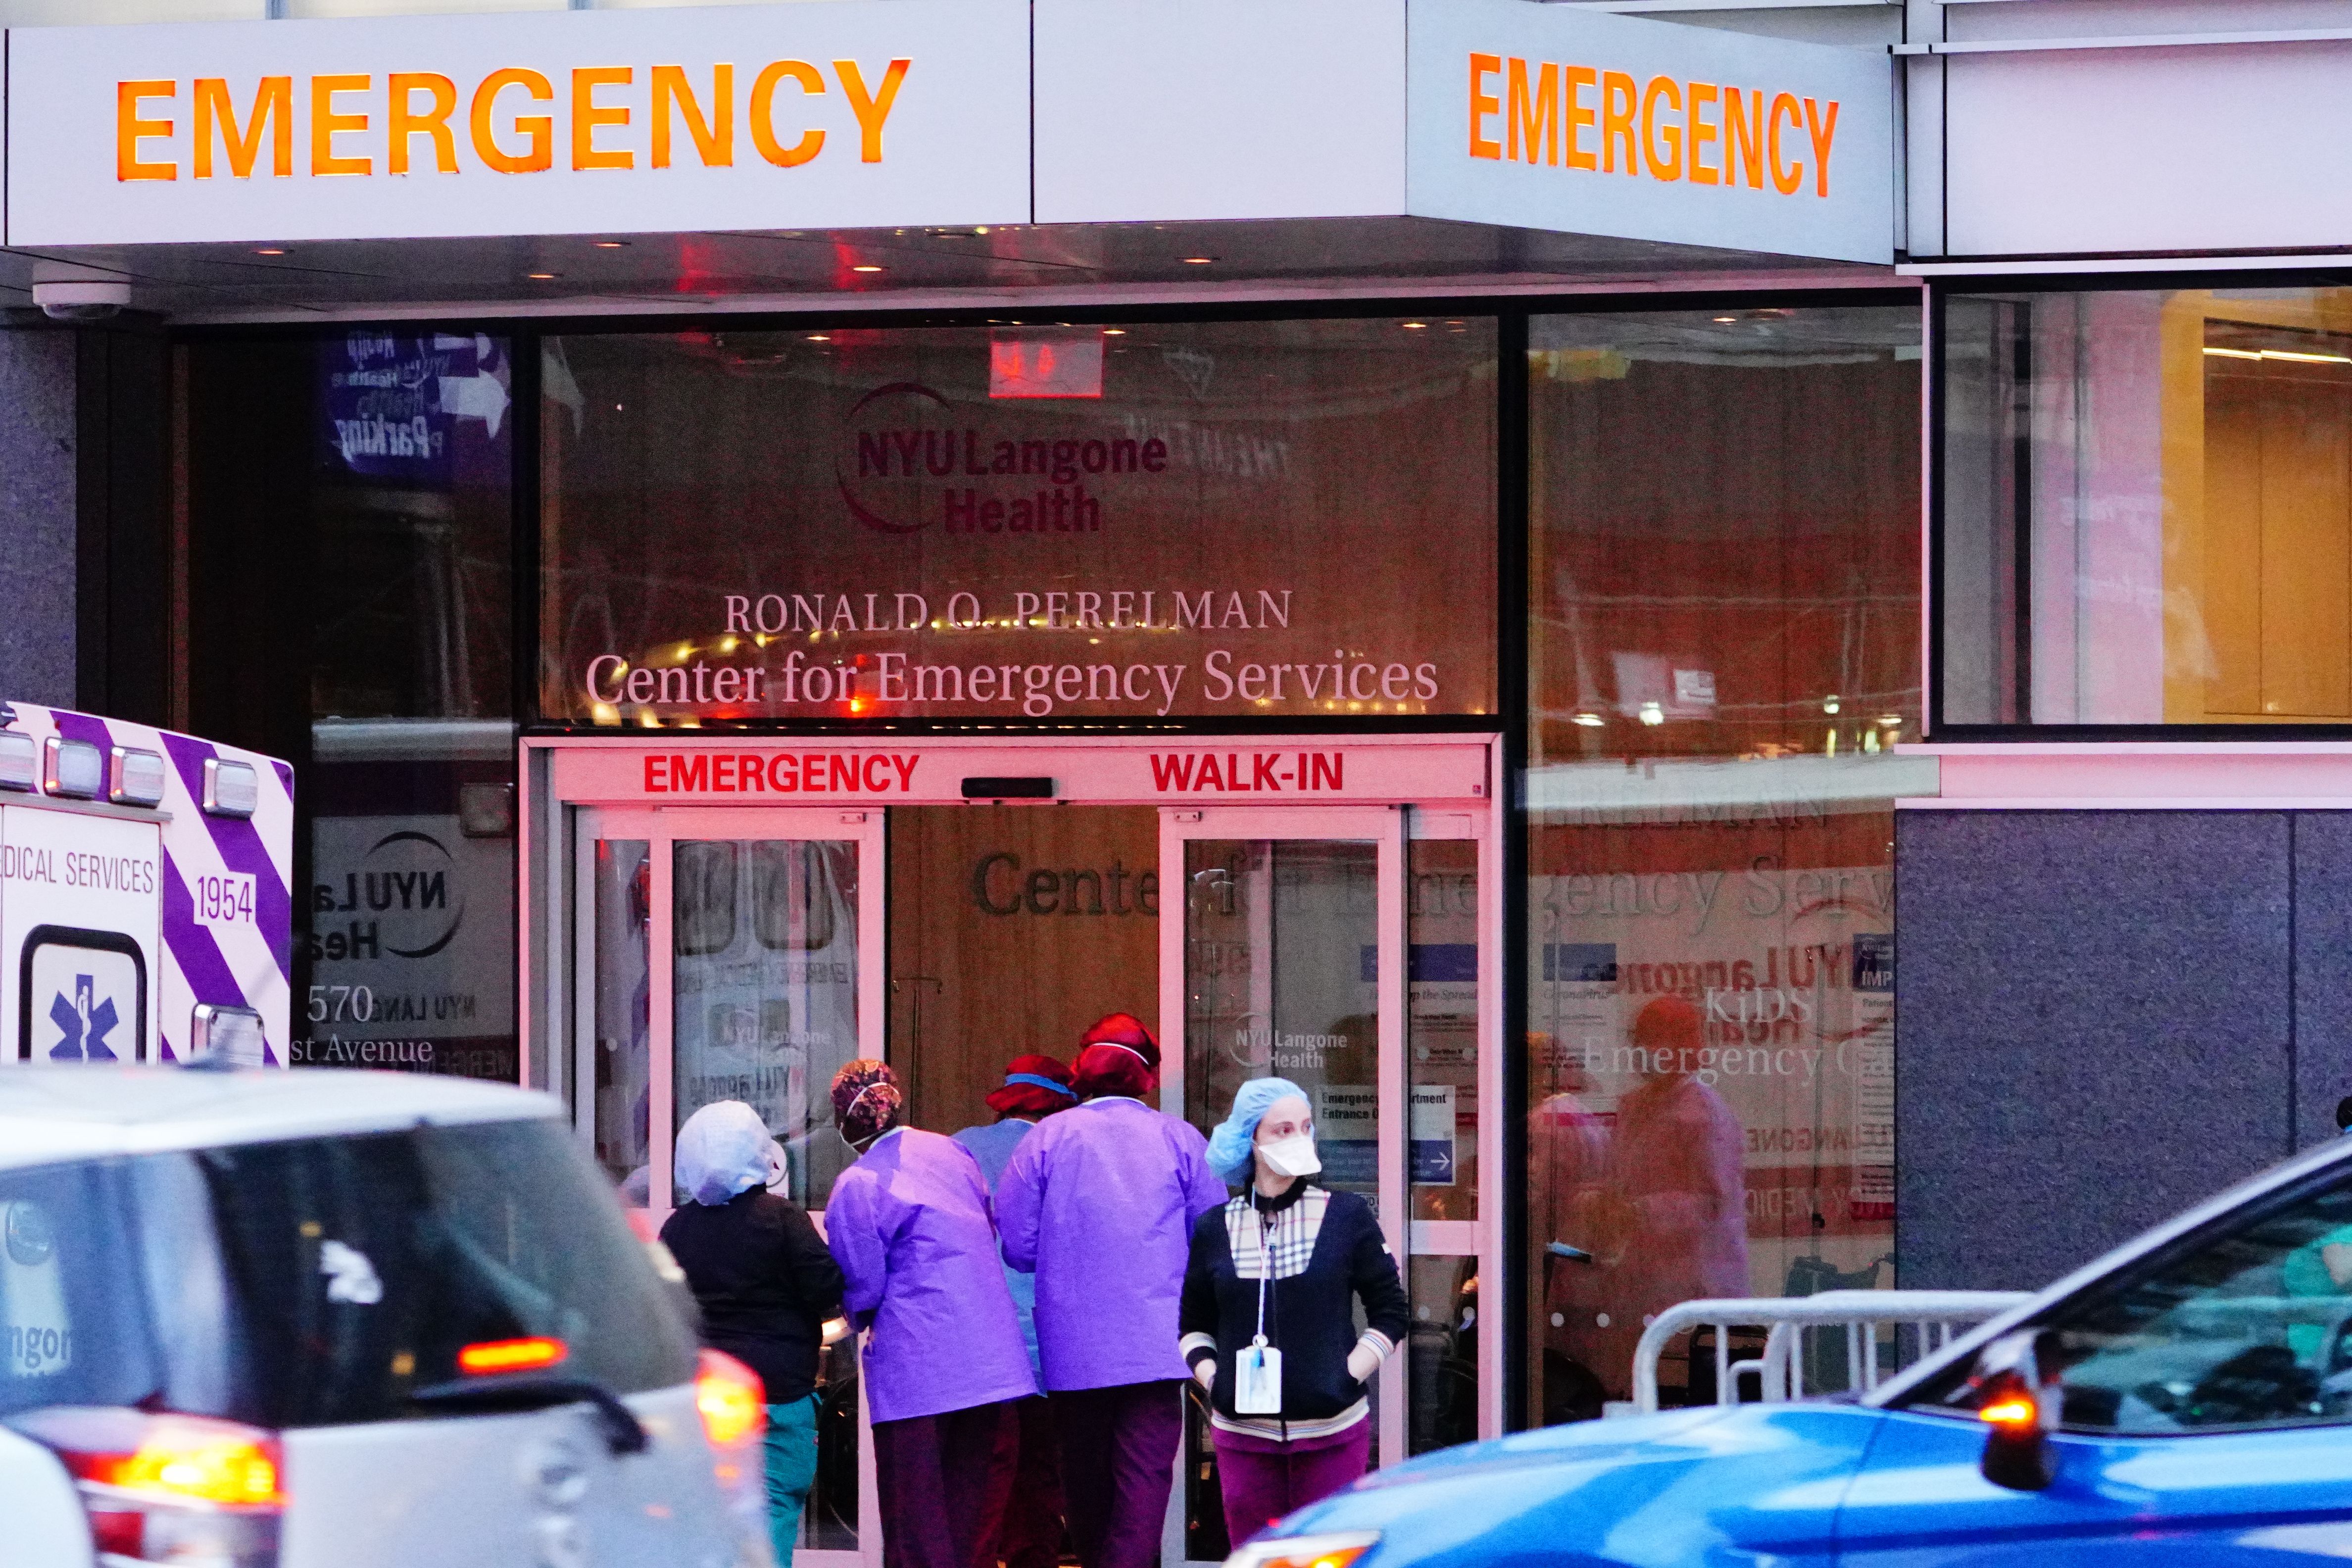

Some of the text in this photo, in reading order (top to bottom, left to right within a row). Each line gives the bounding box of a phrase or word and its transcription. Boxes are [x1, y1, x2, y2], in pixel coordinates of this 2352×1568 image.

[116, 56, 913, 183] EMERGENCY
[1469, 51, 1839, 197] EMERGENCY
[858, 429, 956, 477] NYU
[967, 429, 1167, 485] Langone
[943, 488, 1099, 534] Health
[724, 592, 927, 633] RONALD
[1015, 590, 1293, 630] PERELMAN
[587, 648, 1438, 716] Center for Emergency Services
[644, 754, 920, 793] EMERGENCY
[1151, 753, 1343, 791] WALK-IN
[0, 844, 153, 894] DICAL SERVICES
[973, 851, 1159, 917] Cente
[1744, 854, 1895, 917] Serv
[197, 876, 252, 923] 1954
[1862, 971, 1893, 986] IMP
[307, 985, 373, 1022] 570
[325, 1033, 433, 1063] Avenue
[1236, 1029, 1348, 1051] NYU Langone
[1585, 1037, 1821, 1087] Emergency
[1322, 1108, 1369, 1119] Entrance
[1410, 1094, 1446, 1104] rtment
